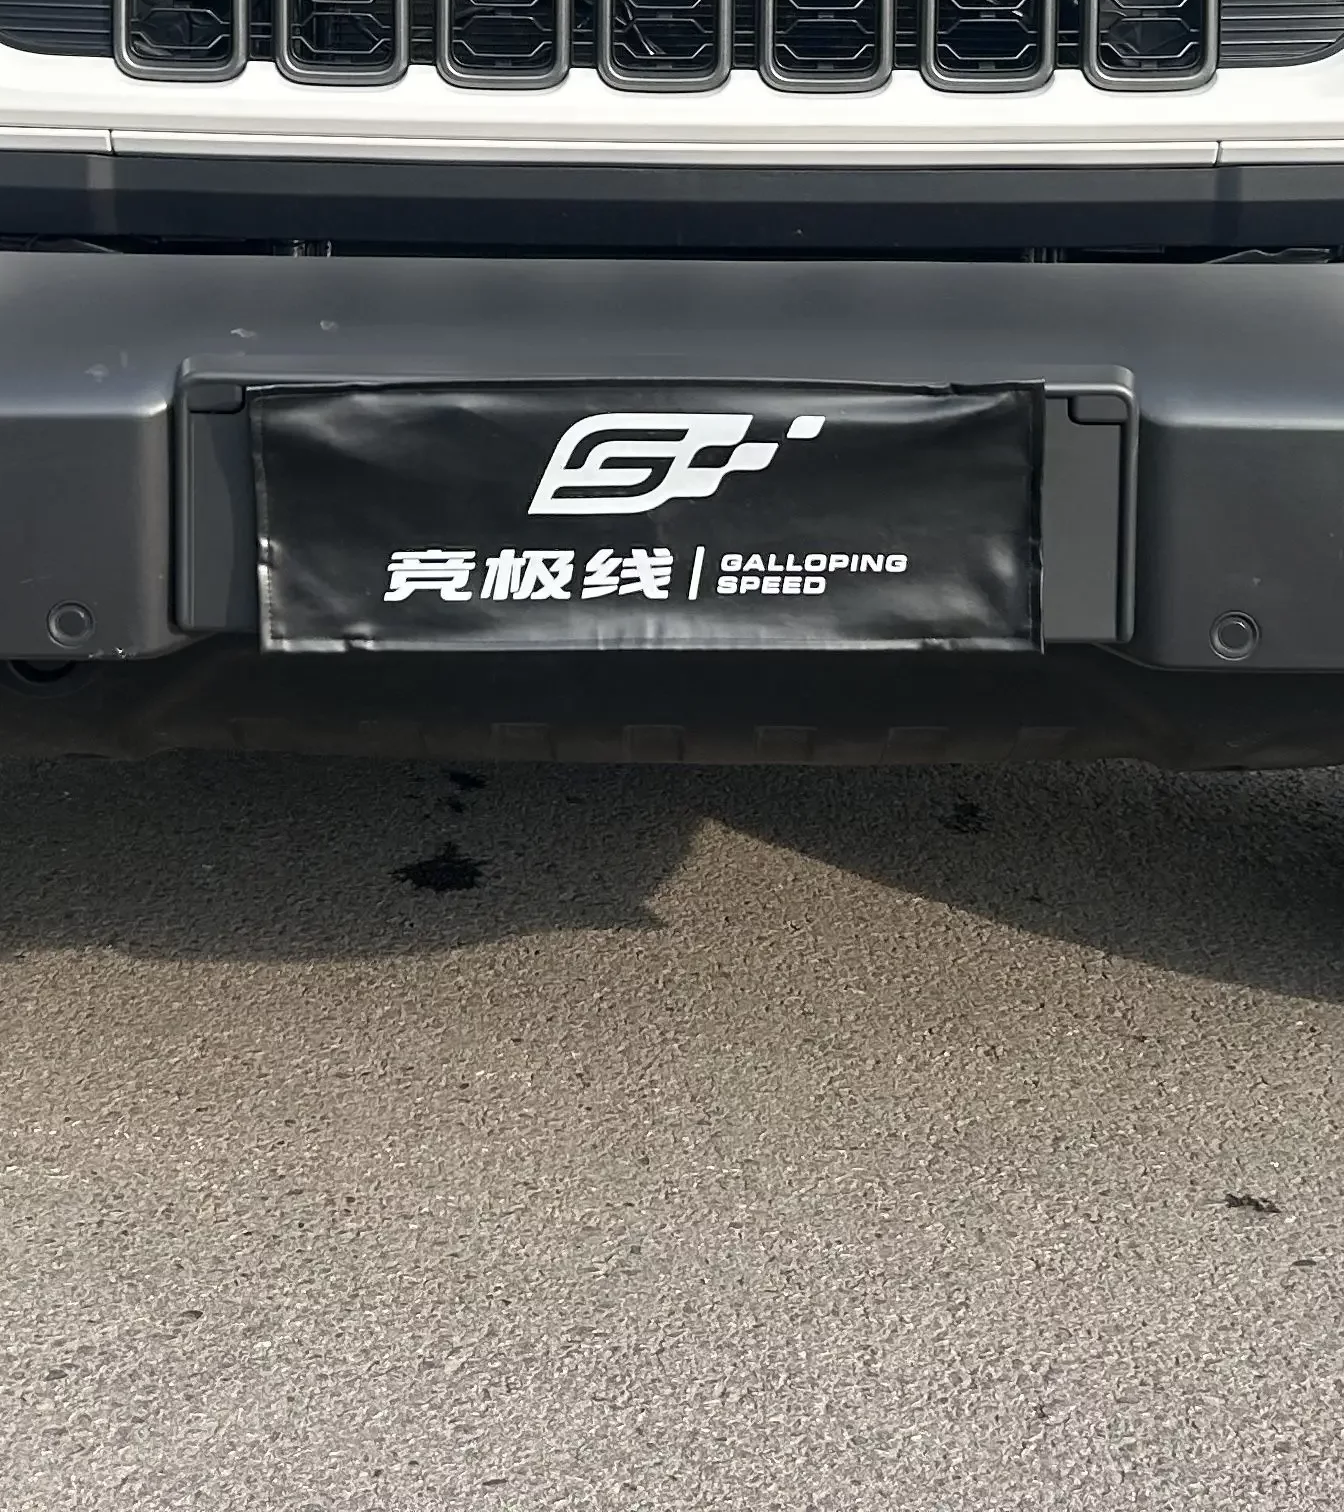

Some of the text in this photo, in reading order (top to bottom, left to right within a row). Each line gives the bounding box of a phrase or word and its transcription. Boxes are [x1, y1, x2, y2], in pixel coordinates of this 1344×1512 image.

[720, 553, 908, 573] GALLOPING
[383, 547, 674, 602] 竞极线
[716, 575, 827, 595] SPEED
